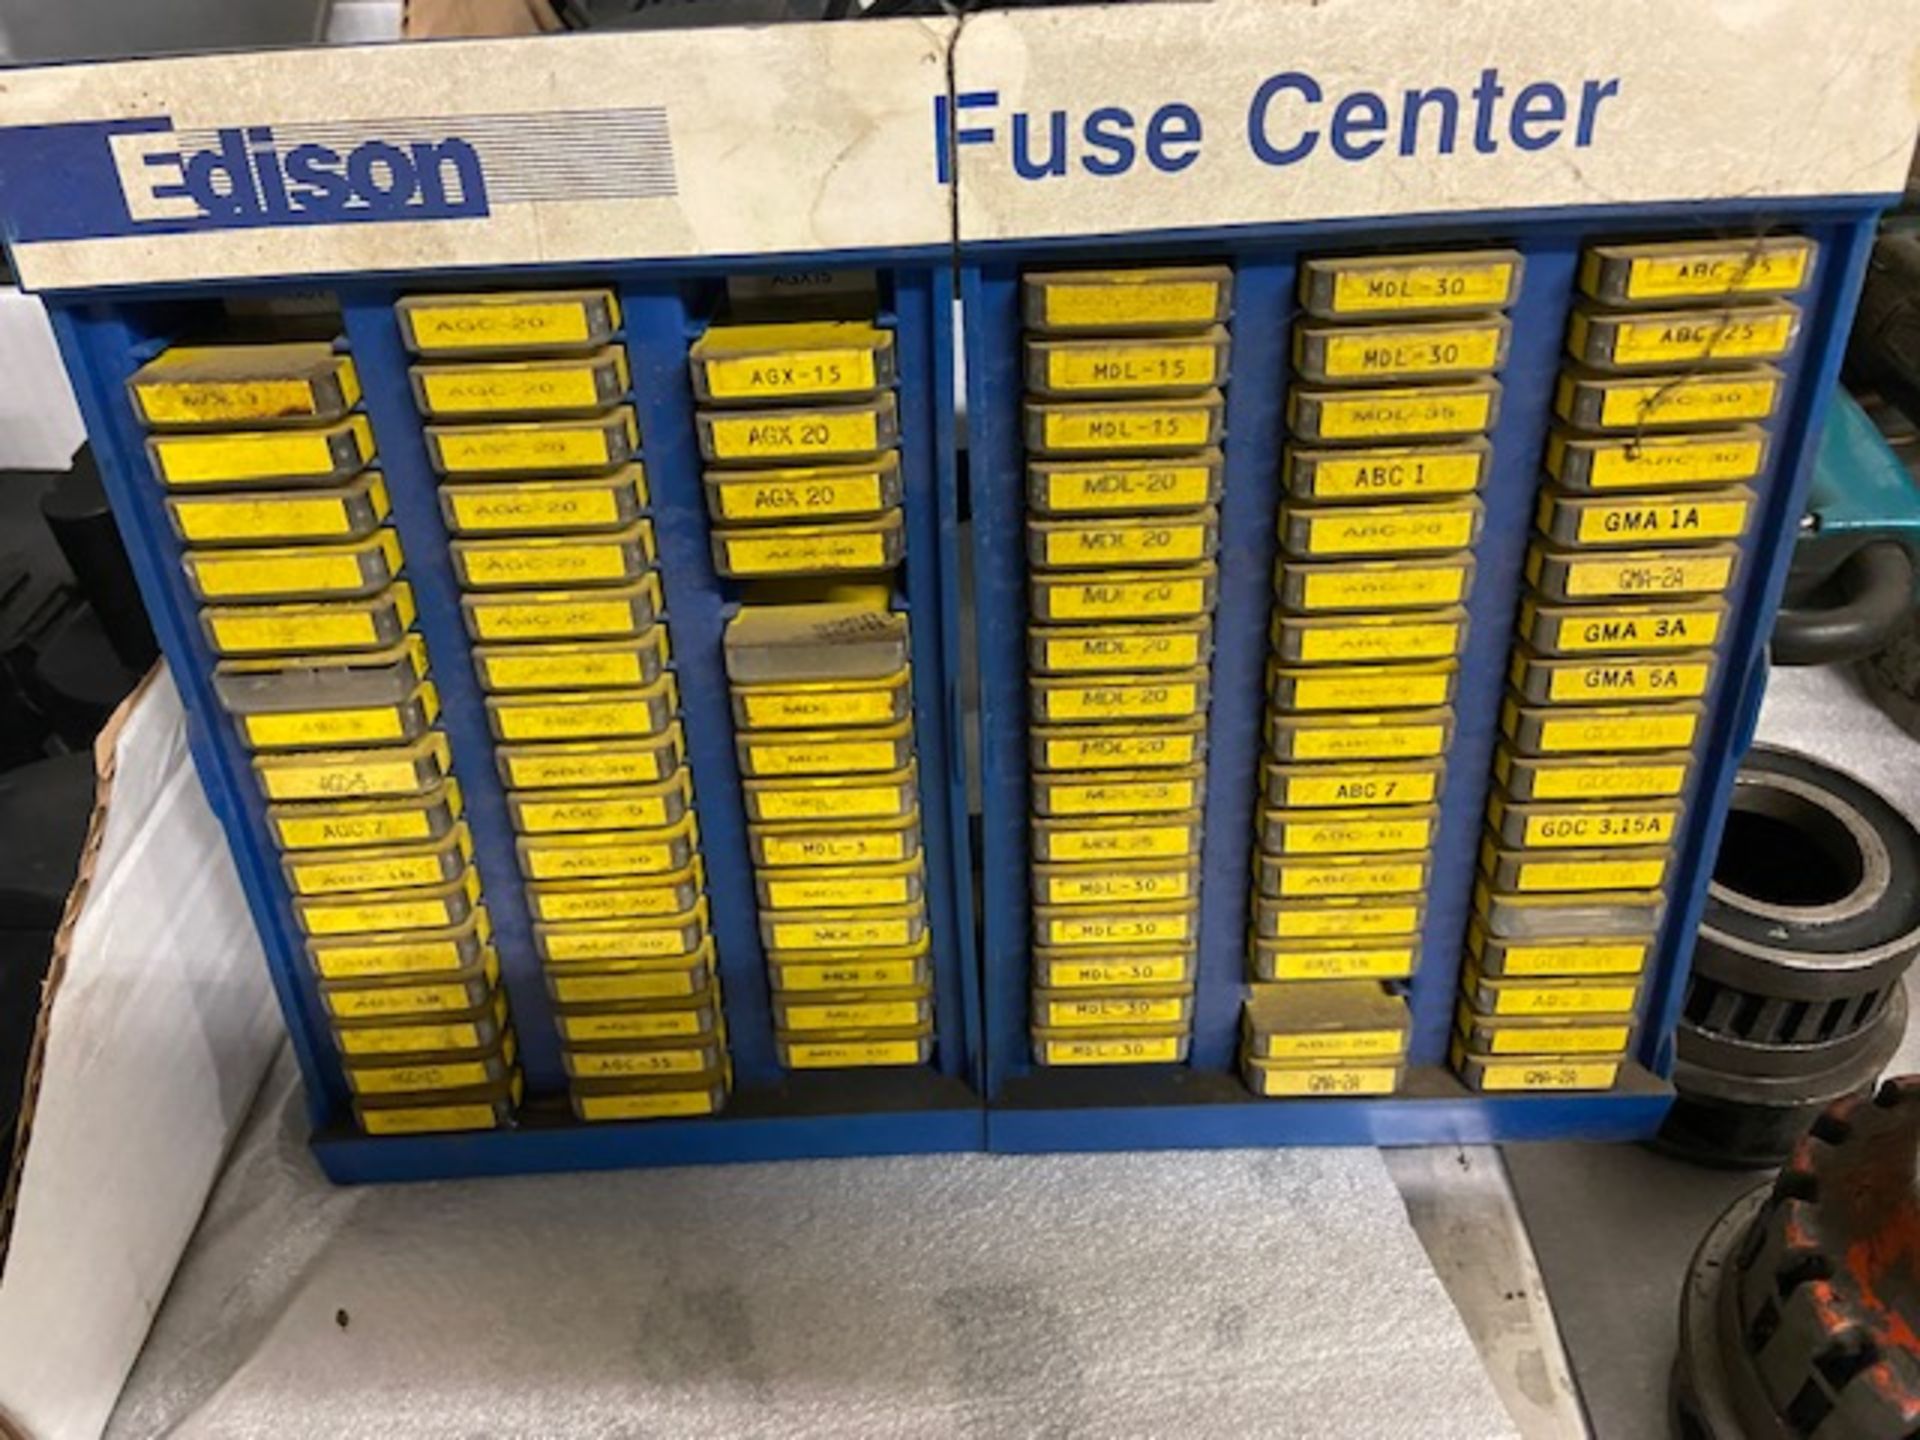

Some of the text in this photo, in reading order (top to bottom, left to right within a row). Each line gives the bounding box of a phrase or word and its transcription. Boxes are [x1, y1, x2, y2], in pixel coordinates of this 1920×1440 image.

[933, 67, 1621, 184] Fuse Center
[108, 123, 489, 221] Edison
[749, 424, 829, 446] AGX 20
[1355, 467, 1403, 488] ABC
[755, 485, 834, 508] AGX 20
[1604, 508, 1700, 532] GMA 1A
[1583, 619, 1687, 643] GMA 3A
[1584, 668, 1636, 688] GMA
[1335, 781, 1398, 799] ABC 7
[1541, 817, 1661, 838] GDC 3.15A
